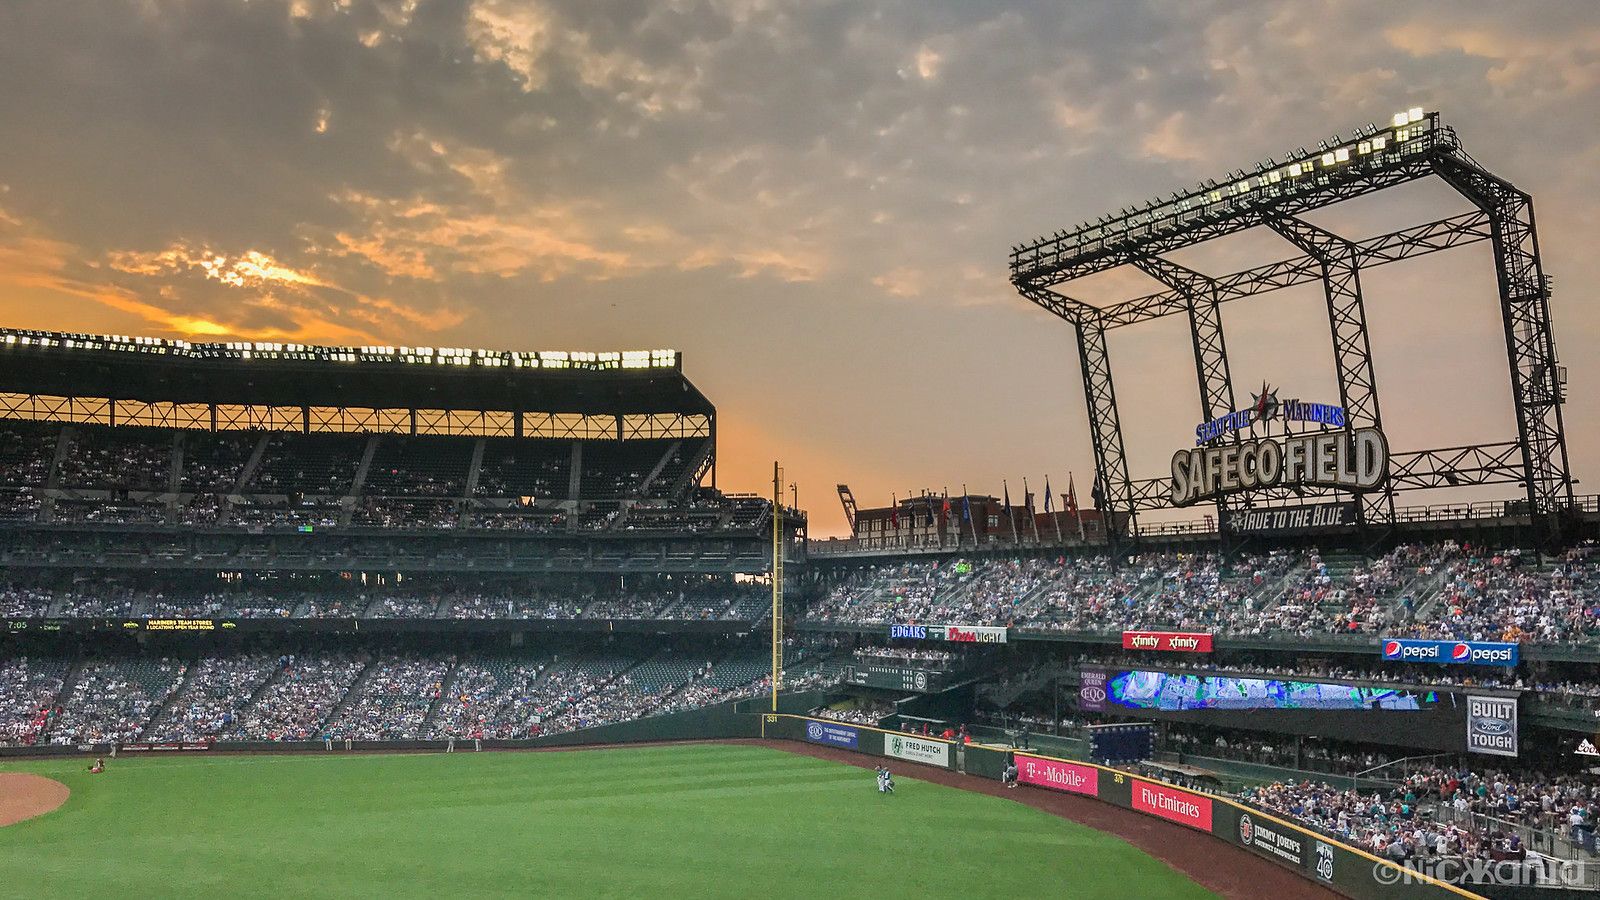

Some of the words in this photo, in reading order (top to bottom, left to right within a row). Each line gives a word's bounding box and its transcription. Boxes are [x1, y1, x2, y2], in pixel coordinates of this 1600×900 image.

[1196, 409, 1250, 445] SEATTLE
[1283, 399, 1345, 427] MARINERS
[1171, 438, 1283, 506] SAFECO
[1285, 427, 1388, 490] FIELD
[1243, 510, 1271, 530] TRUE
[1273, 511, 1287, 529] TO
[1289, 509, 1311, 527] THE
[1312, 505, 1344, 526] BLUE
[8, 621, 27, 629] 7:05
[891, 626, 926, 639] EDGARS
[1131, 635, 1160, 648] xfinity
[1169, 636, 1199, 650] xfinity
[1403, 645, 1440, 659] pepsi
[1472, 648, 1512, 662] pepsi
[1472, 702, 1512, 719] BUILT
[766, 715, 778, 723] 331
[1481, 723, 1502, 732] Ford
[905, 741, 921, 751] FRED
[921, 744, 941, 754] HUTCH
[1472, 734, 1512, 749] TOUGH
[1114, 773, 1124, 784] 376
[1142, 788, 1157, 807] Fly
[1159, 793, 1200, 818] Emirates
[1254, 824, 1276, 843] JIMMY
